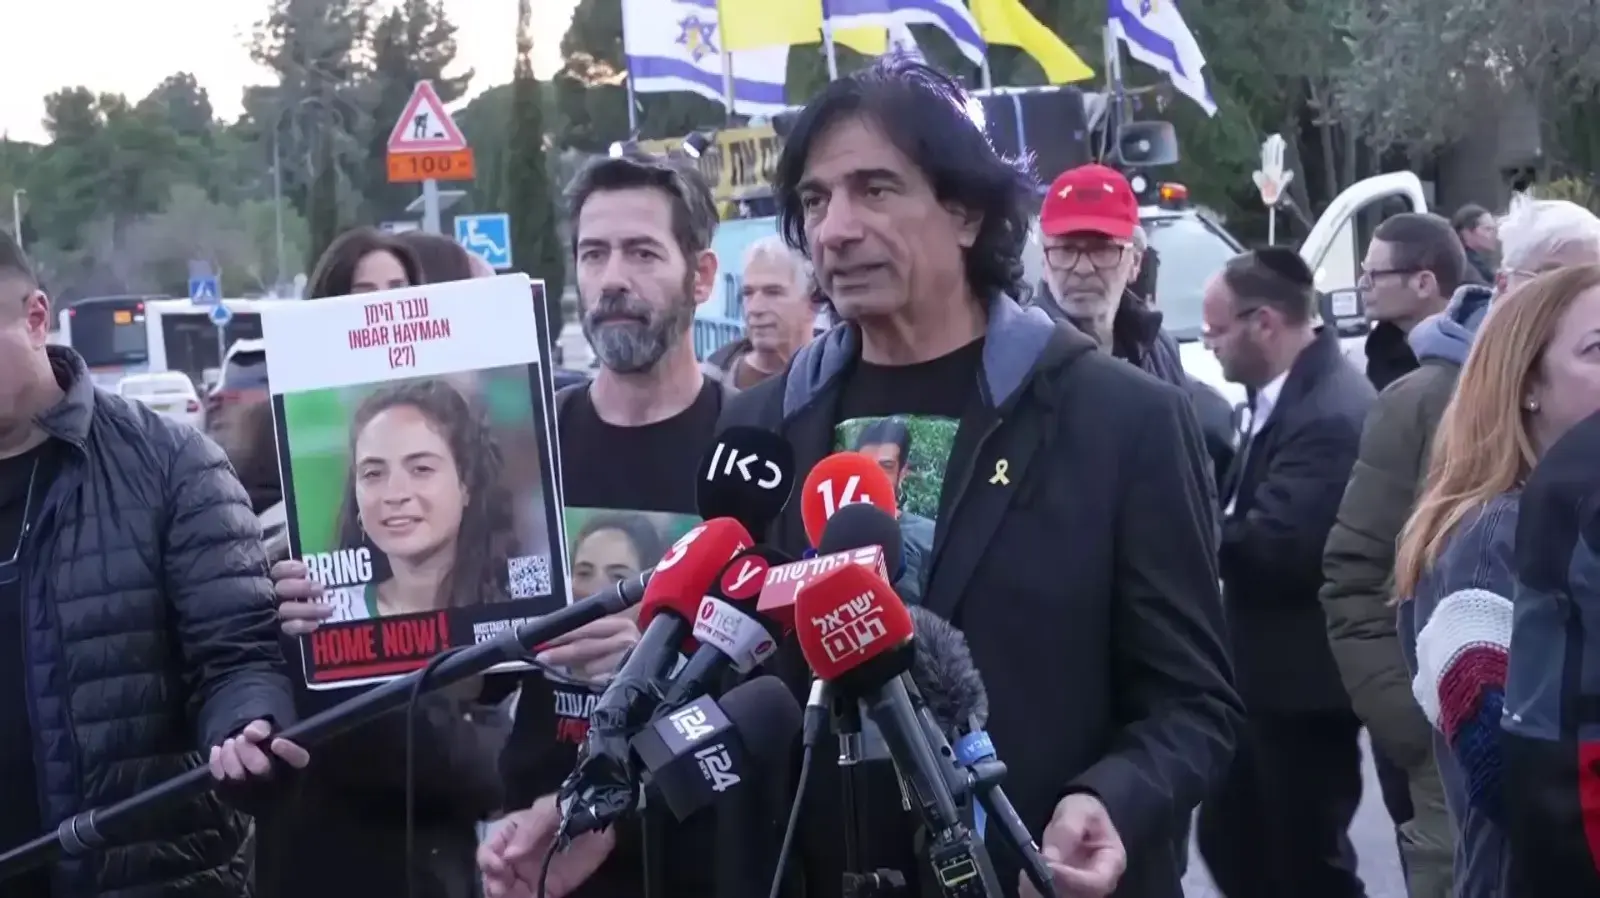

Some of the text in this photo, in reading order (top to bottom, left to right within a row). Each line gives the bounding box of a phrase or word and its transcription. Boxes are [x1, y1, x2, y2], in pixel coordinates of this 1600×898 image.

[410, 156, 452, 173] 100
[364, 298, 429, 326] ענבר הימן
[348, 318, 451, 350] INBAR HAYMAN
[388, 344, 416, 369] (27)
[706, 442, 782, 489] כאן
[303, 547, 373, 586] BRING
[811, 590, 876, 635] ישראל
[312, 611, 450, 665] HOME NOW!
